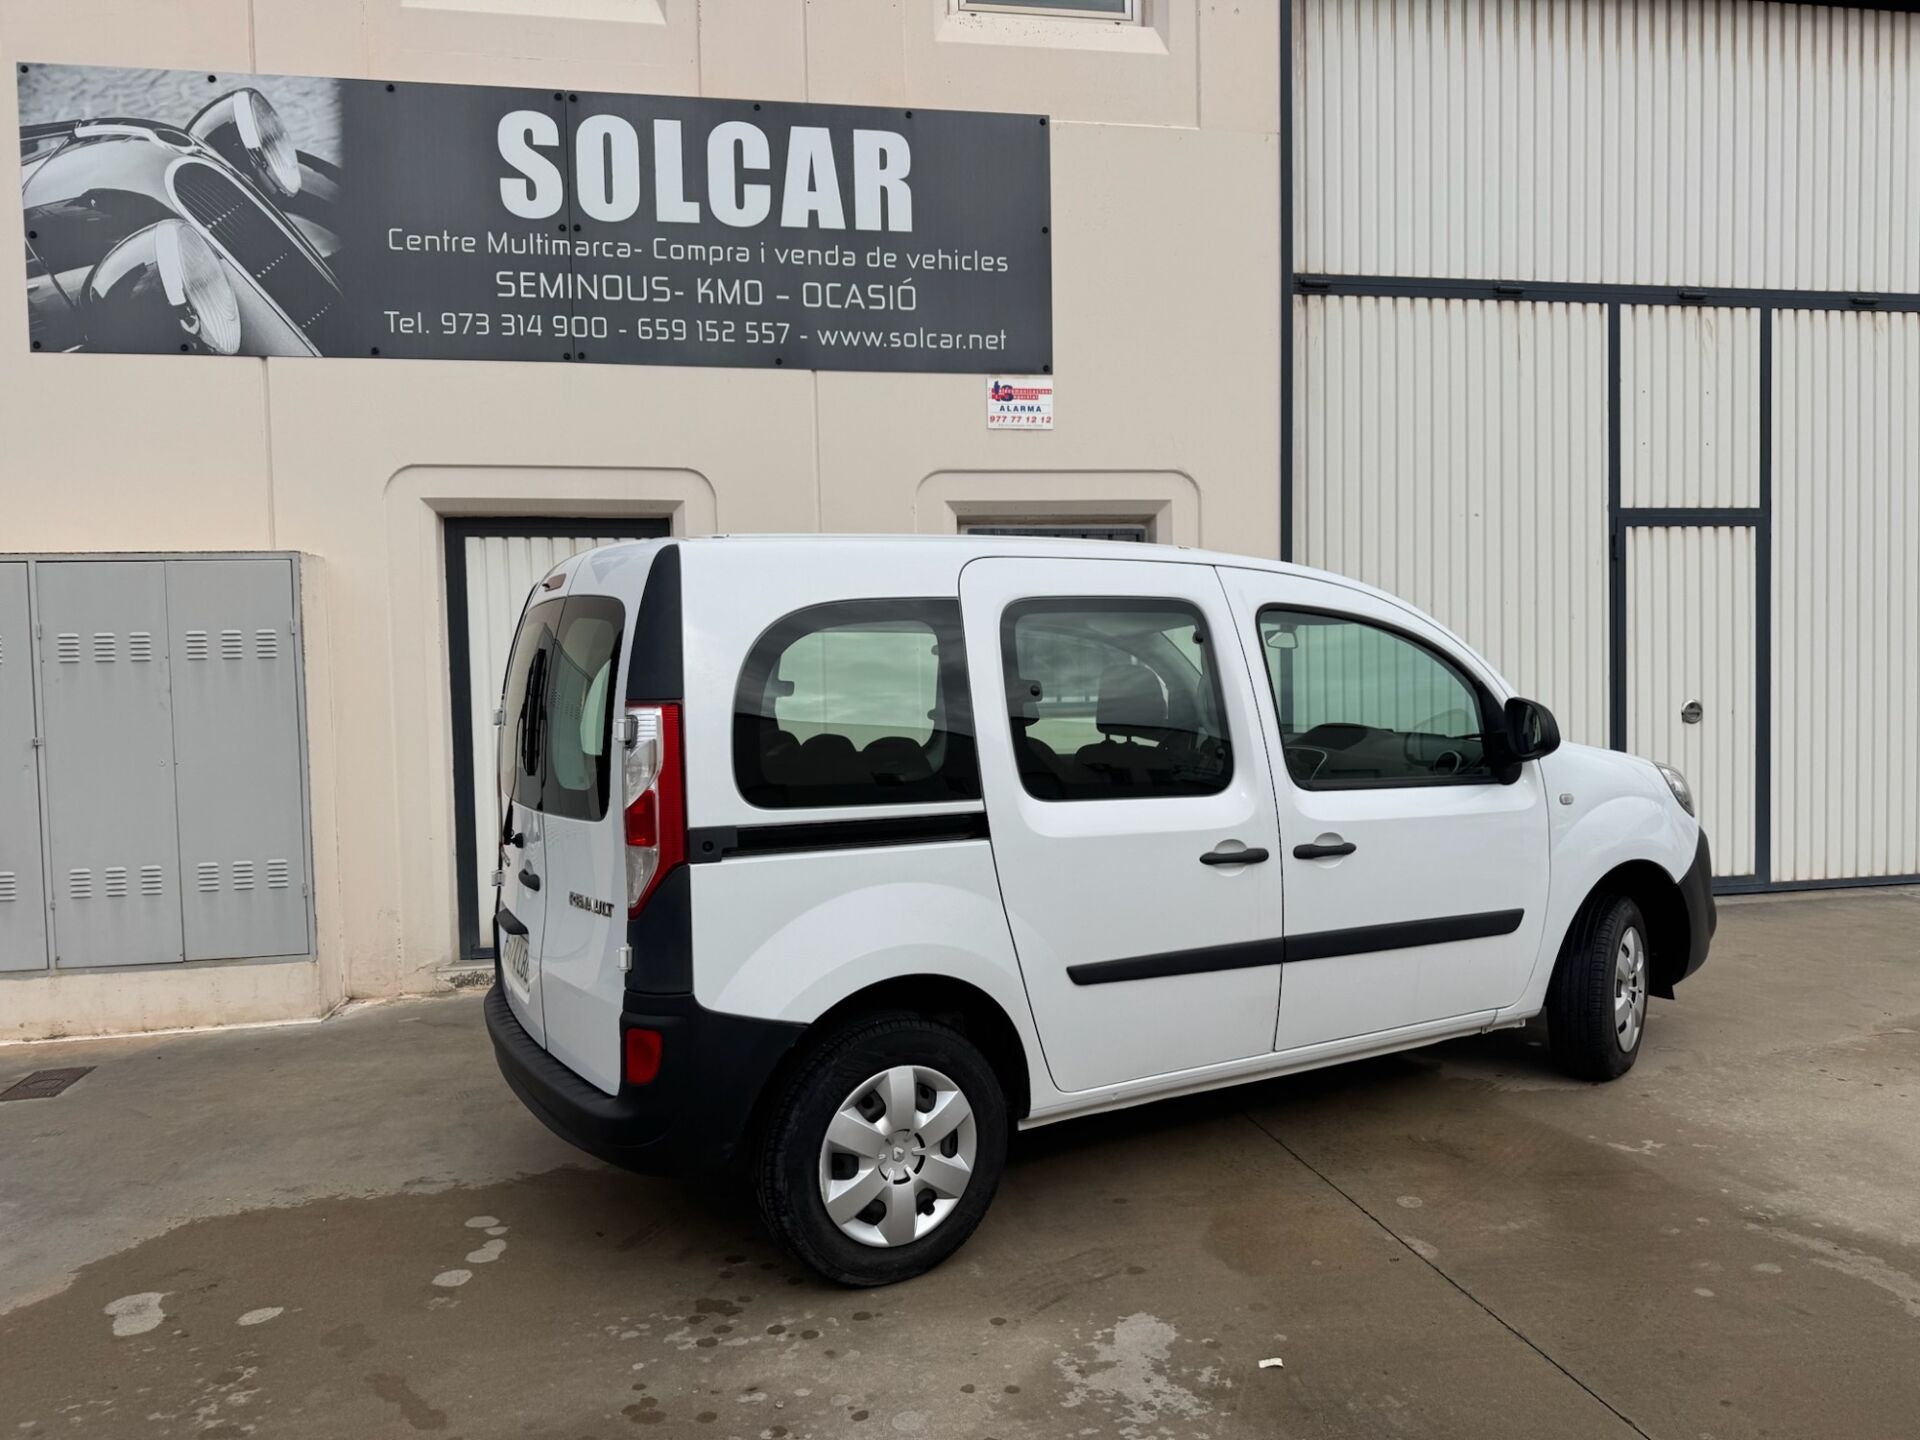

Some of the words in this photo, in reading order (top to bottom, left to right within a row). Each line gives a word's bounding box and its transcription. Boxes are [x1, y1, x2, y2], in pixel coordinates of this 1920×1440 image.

[497, 109, 913, 233] SOLCAR
[388, 227, 477, 253] Centre
[652, 237, 750, 266] Compra
[760, 241, 766, 264] i
[774, 244, 856, 267] venda
[866, 246, 898, 269] de
[906, 248, 1009, 273] vehicles
[802, 276, 917, 312] OCASIÓ
[383, 310, 430, 335] Tel.
[440, 312, 490, 336] 973
[500, 314, 543, 337] 314
[552, 315, 608, 339] 900
[637, 317, 687, 341] 659
[696, 319, 736, 343] 152
[745, 321, 790, 345] 557
[816, 328, 1007, 351] www.solcar.net
[989, 415, 1007, 424] 977
[1010, 415, 1022, 424] 77
[1026, 416, 1037, 424] 12
[1041, 416, 1052, 424] 12
[999, 405, 1042, 413] ALARMA
